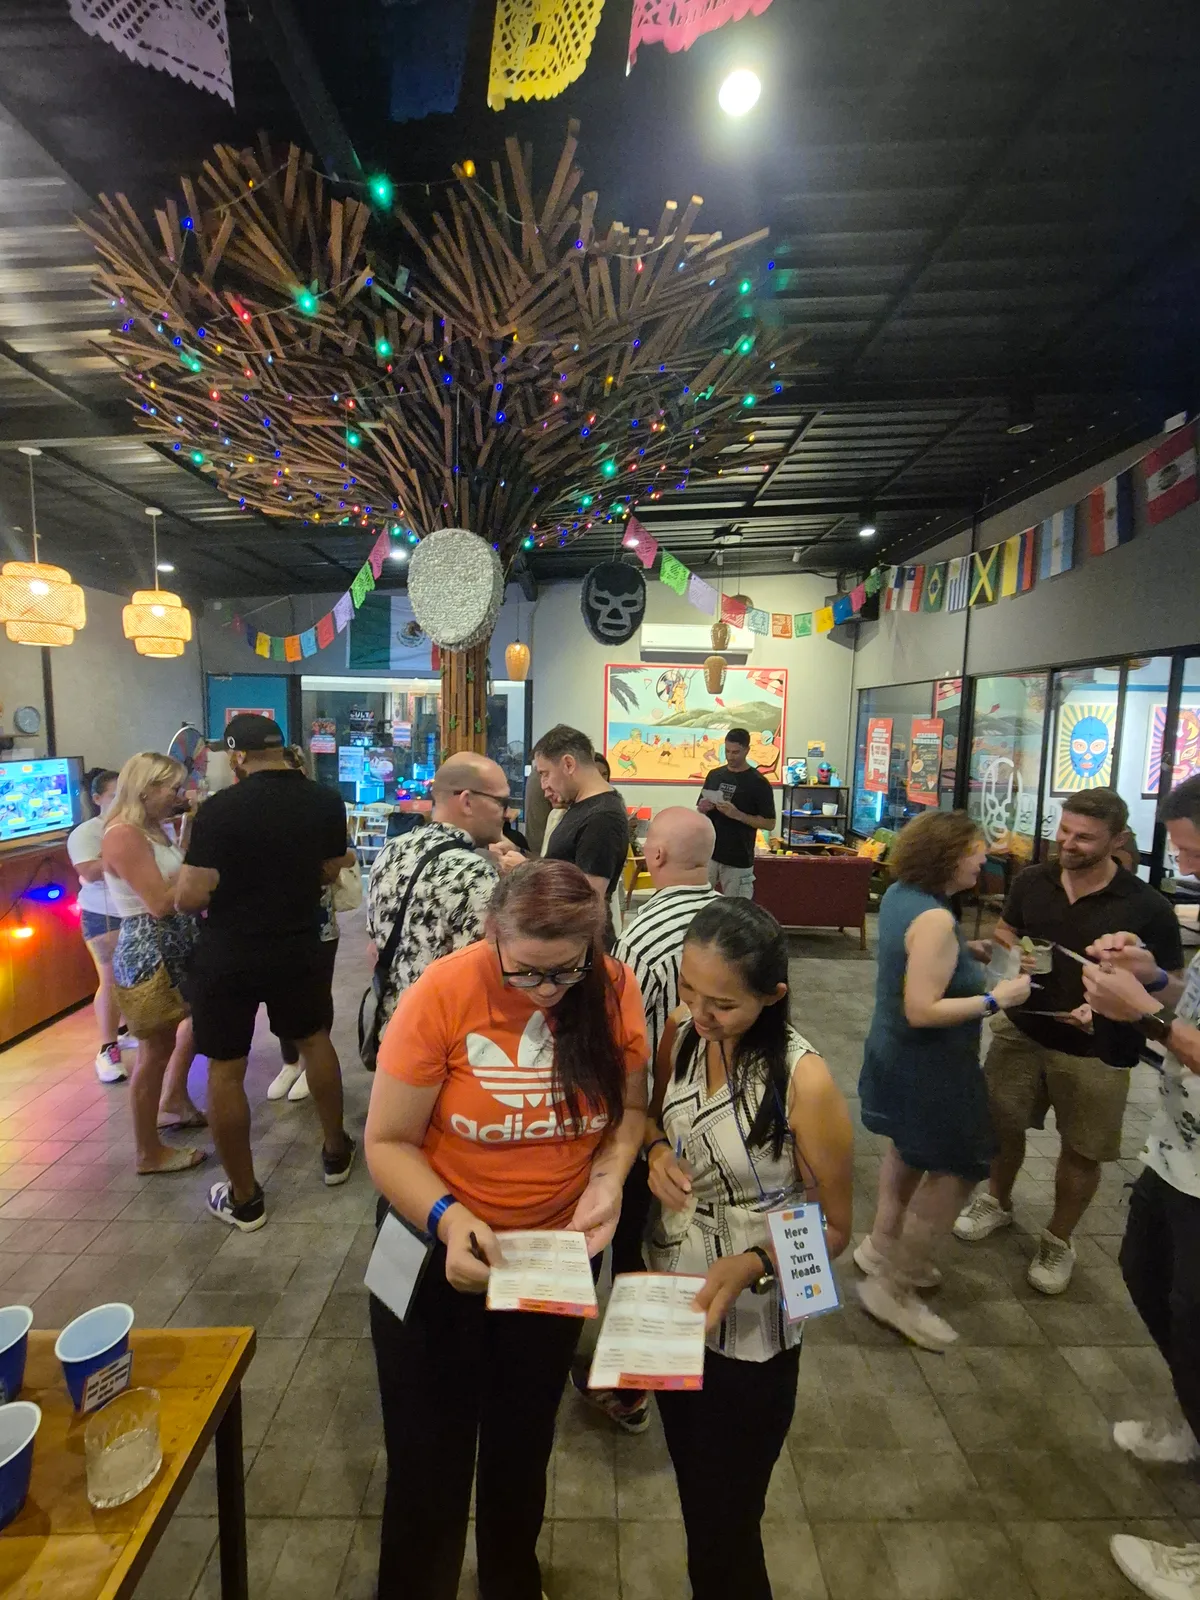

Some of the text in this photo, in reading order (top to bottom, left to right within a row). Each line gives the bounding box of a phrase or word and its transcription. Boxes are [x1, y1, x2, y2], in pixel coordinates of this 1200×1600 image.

[784, 1227, 808, 1239] Here
[793, 1240, 805, 1250] to
[790, 1253, 814, 1265] Turn
[791, 1264, 821, 1280] Heads
